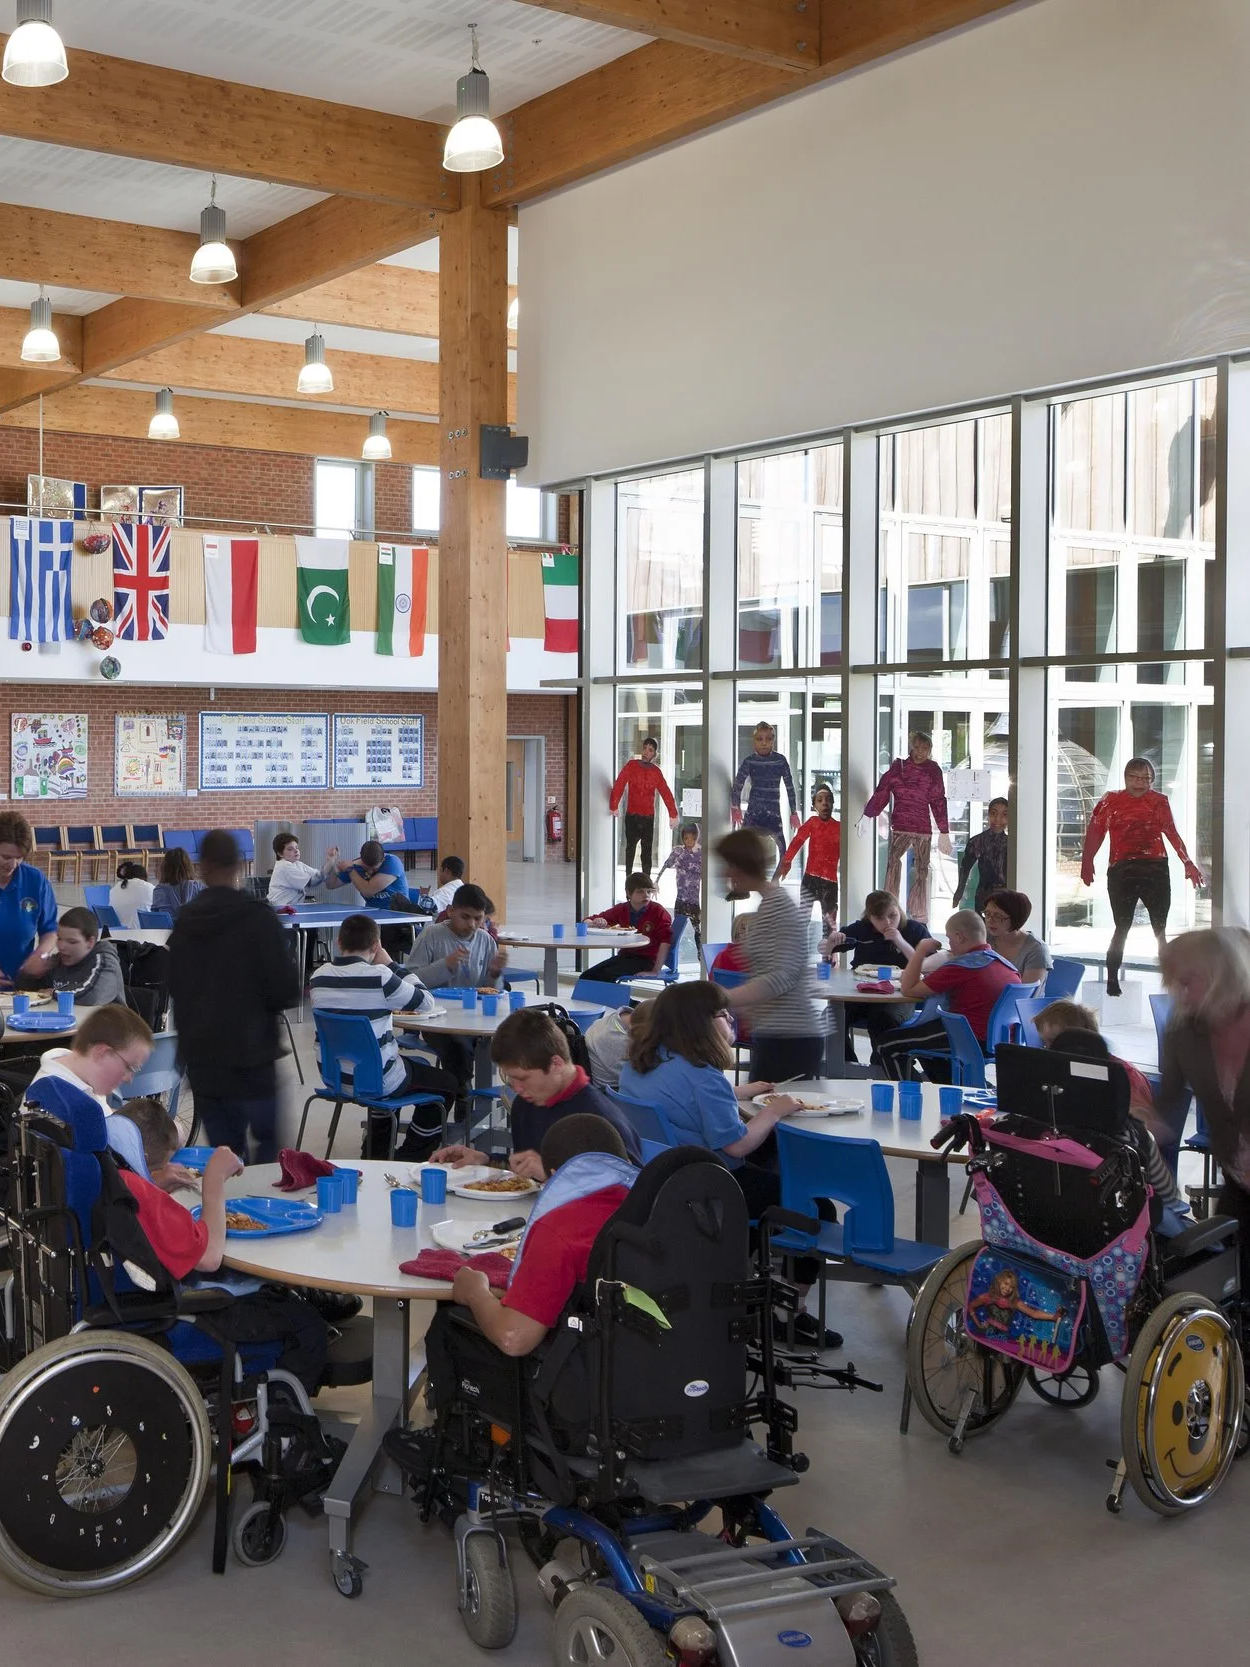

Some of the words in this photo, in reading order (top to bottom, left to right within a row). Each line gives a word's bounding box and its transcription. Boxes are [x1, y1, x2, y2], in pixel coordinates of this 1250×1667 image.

[221, 714, 236, 724] Oak
[237, 714, 256, 725] Field
[258, 714, 285, 725] School
[286, 715, 305, 725] Staff
[340, 716, 355, 725] Oak
[356, 716, 374, 725] Field
[375, 717, 400, 726] School
[400, 717, 419, 726] Staff
